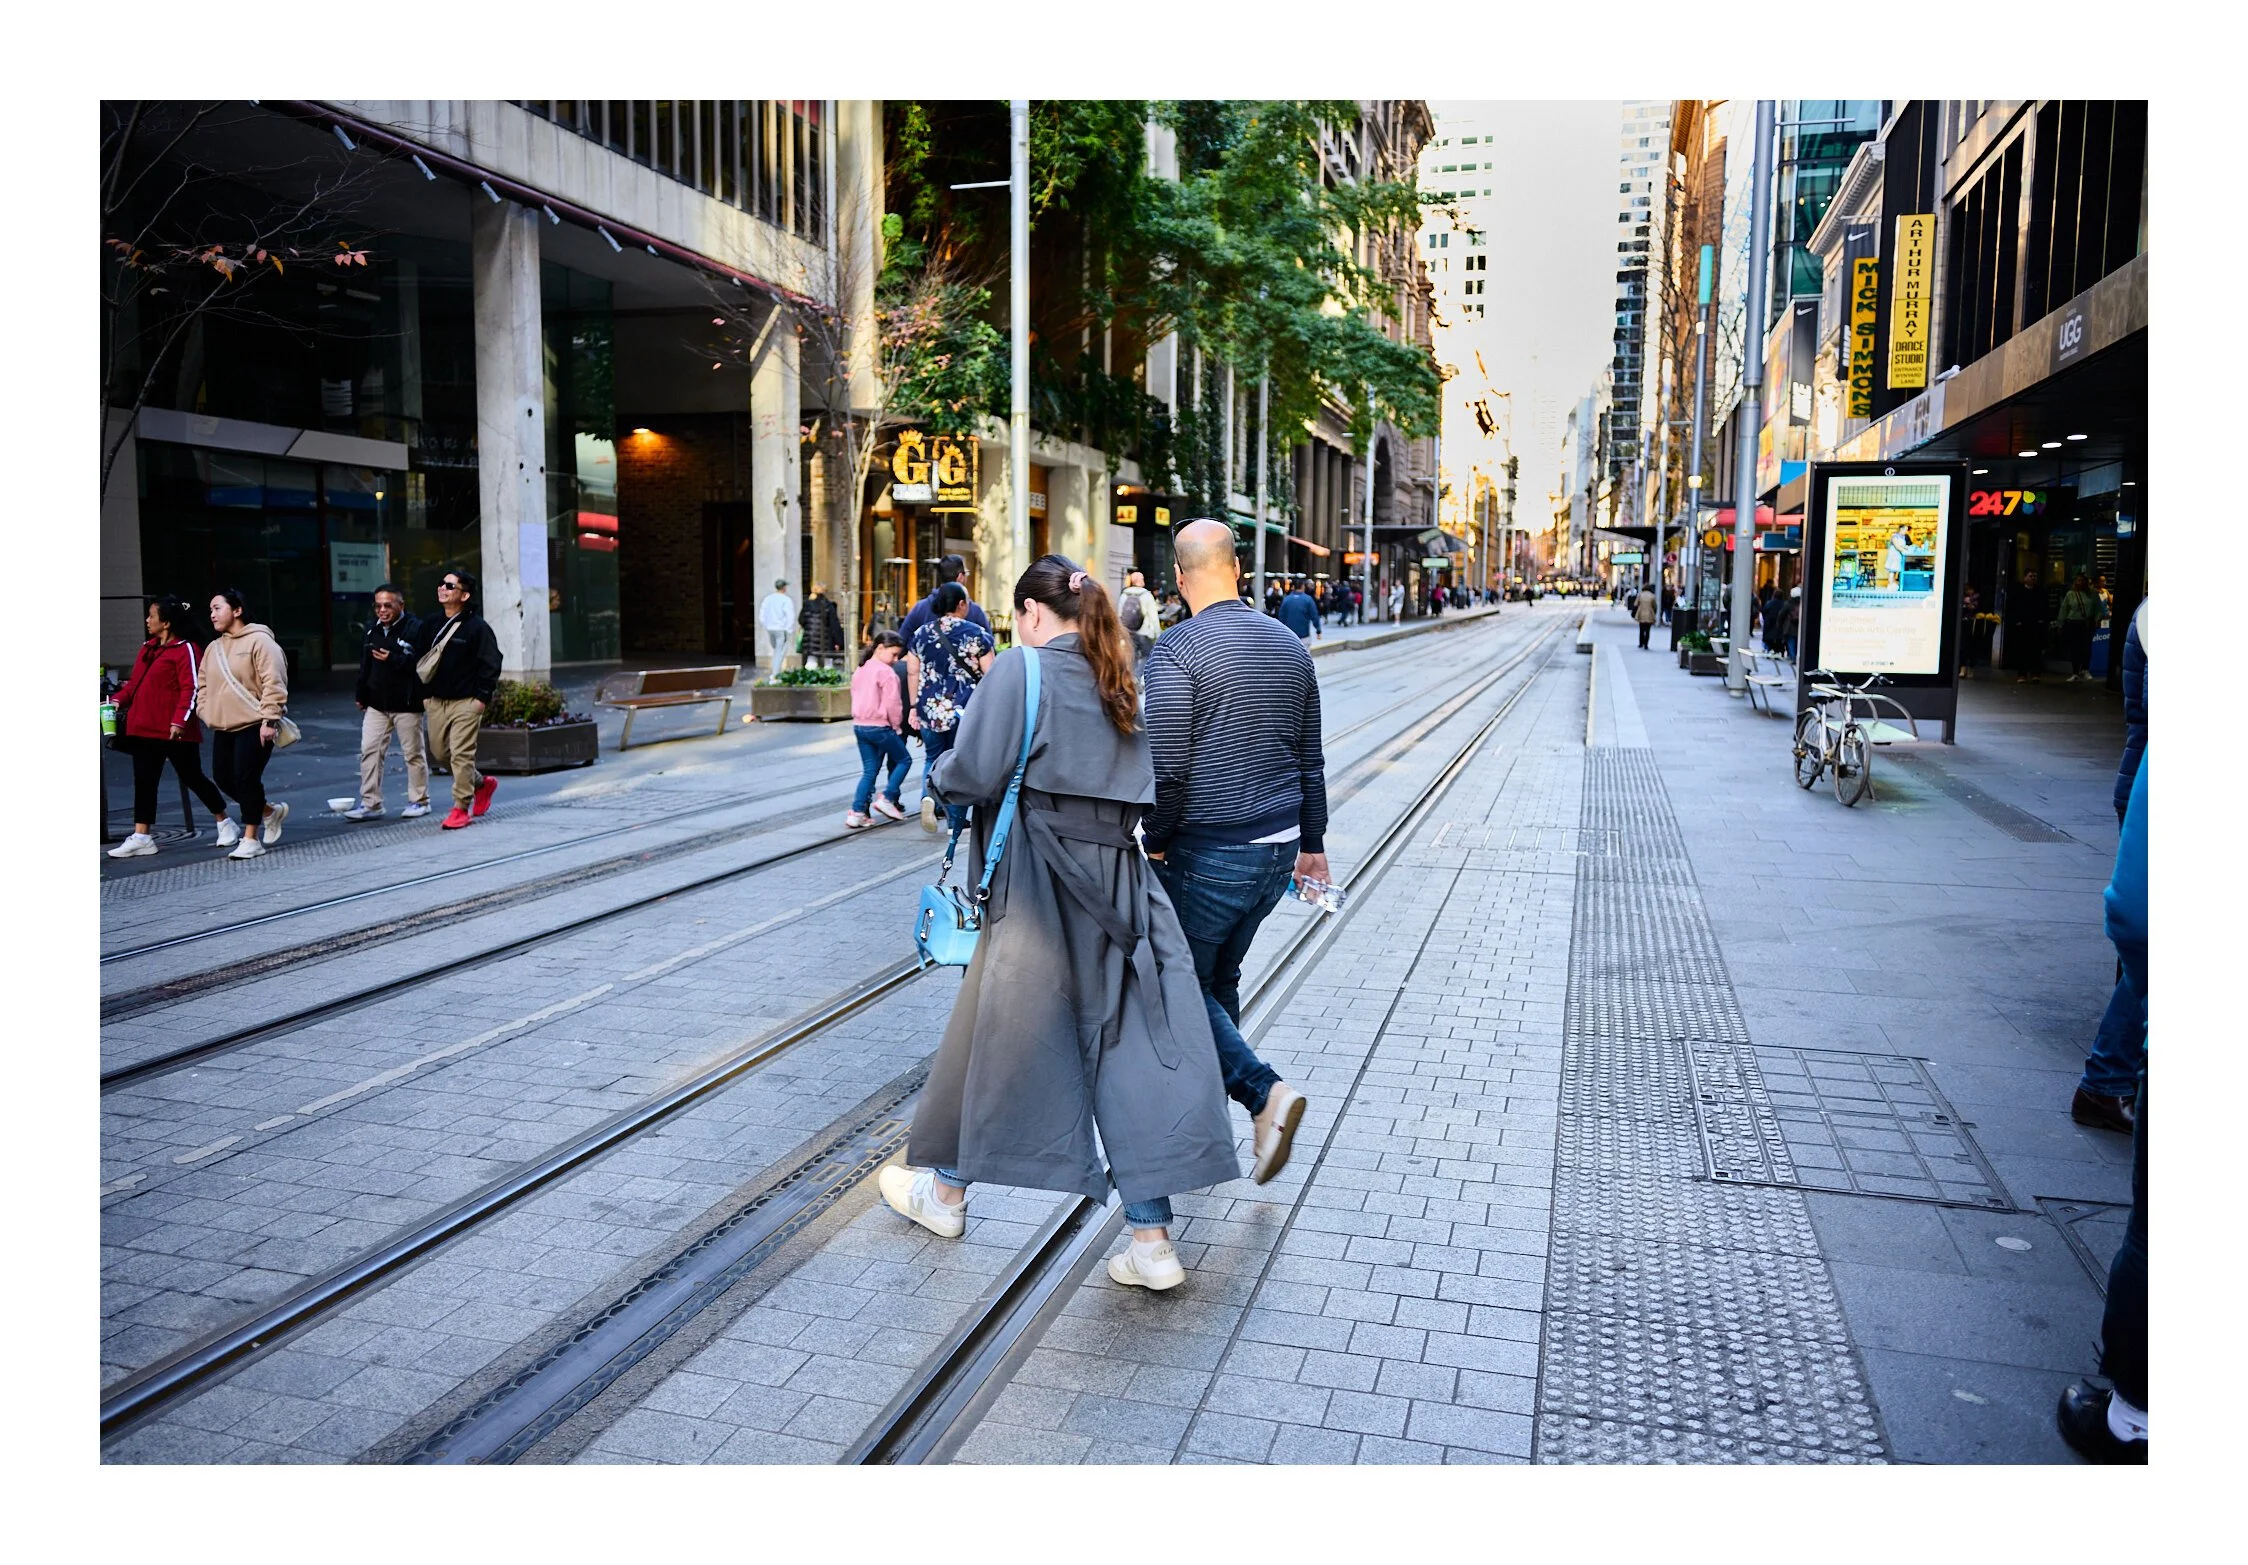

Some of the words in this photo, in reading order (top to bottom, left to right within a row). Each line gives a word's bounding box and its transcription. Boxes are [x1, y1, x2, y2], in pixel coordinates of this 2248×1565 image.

[1907, 219, 1923, 277] ARTHUR
[1856, 262, 1879, 313] MICK
[1905, 281, 1920, 338] MURRAY
[1895, 341, 1924, 352] DANCE
[2059, 314, 2082, 351] UGG
[1851, 322, 1875, 417] SIMMONS
[1894, 353, 1924, 364] STUDIO
[1969, 490, 2022, 516] 247
